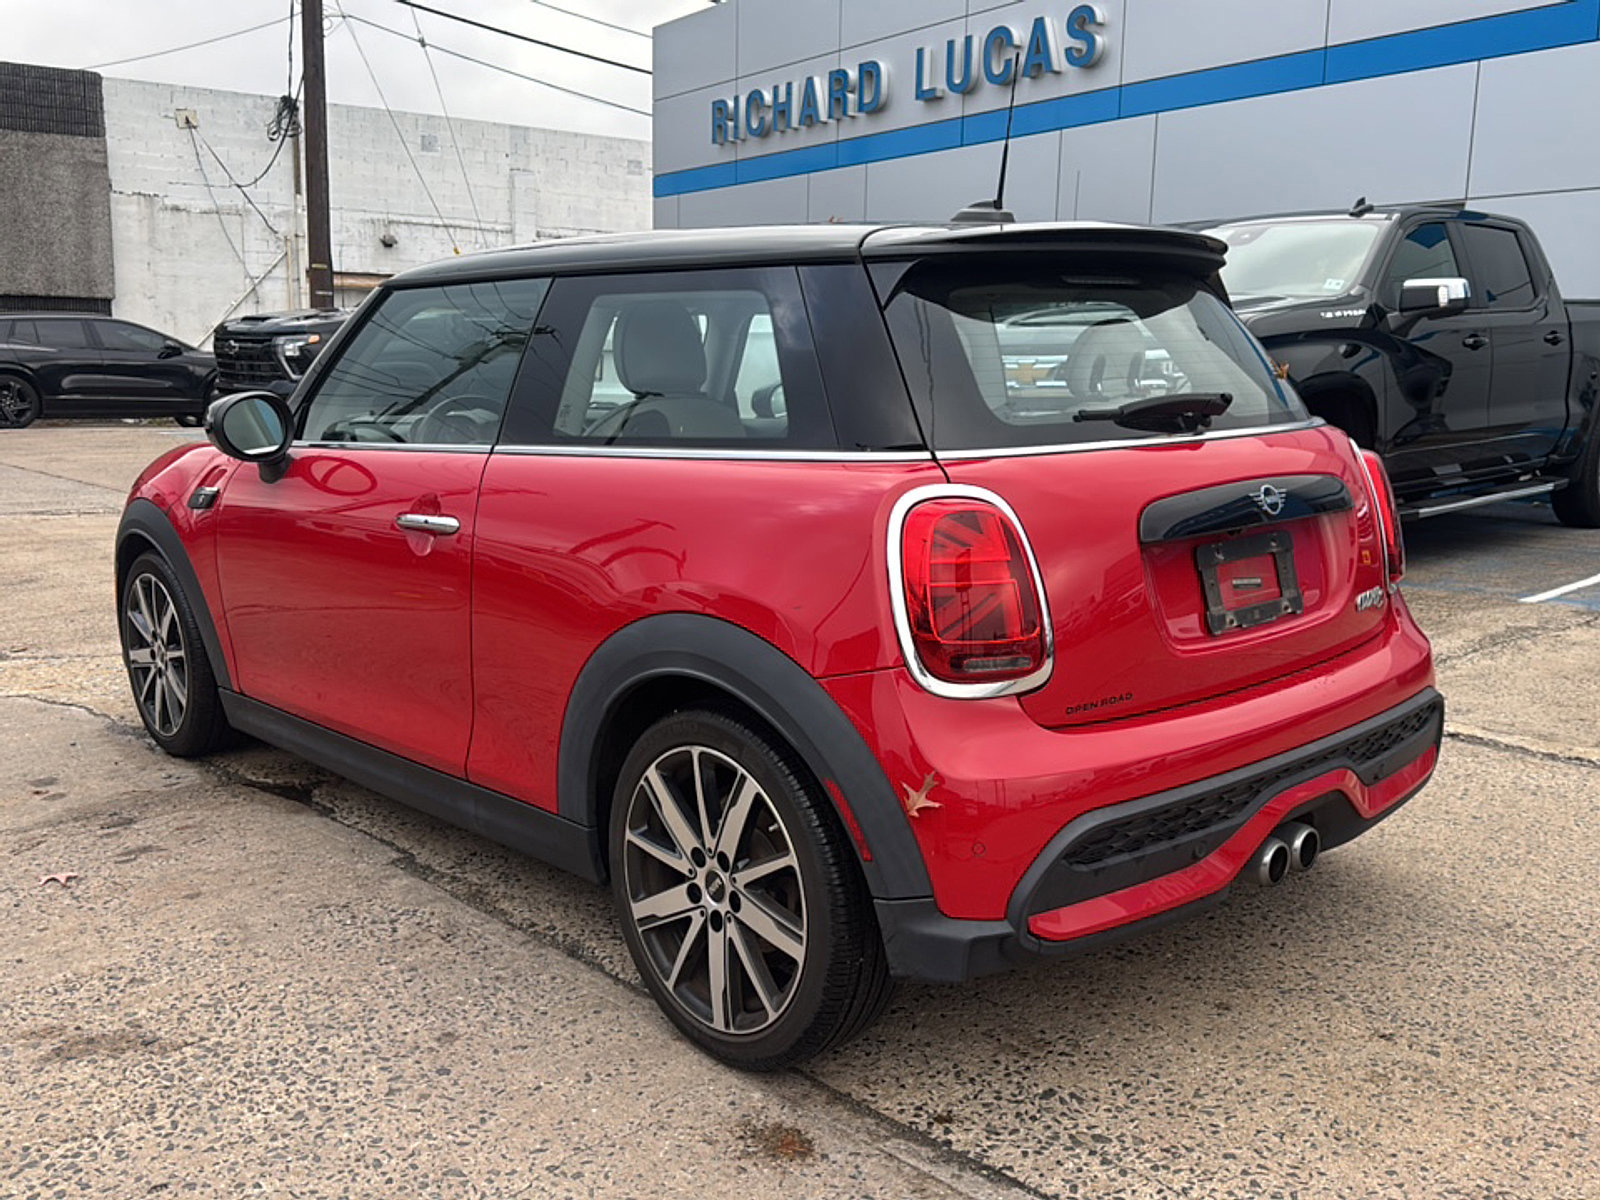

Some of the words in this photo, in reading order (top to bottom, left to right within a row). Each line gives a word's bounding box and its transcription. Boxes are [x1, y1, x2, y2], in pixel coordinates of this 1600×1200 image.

[711, 60, 889, 145] RICHARD
[914, 4, 1105, 101] LUCAS
[1065, 702, 1098, 715] OPEN
[1099, 691, 1134, 707] ROAD
